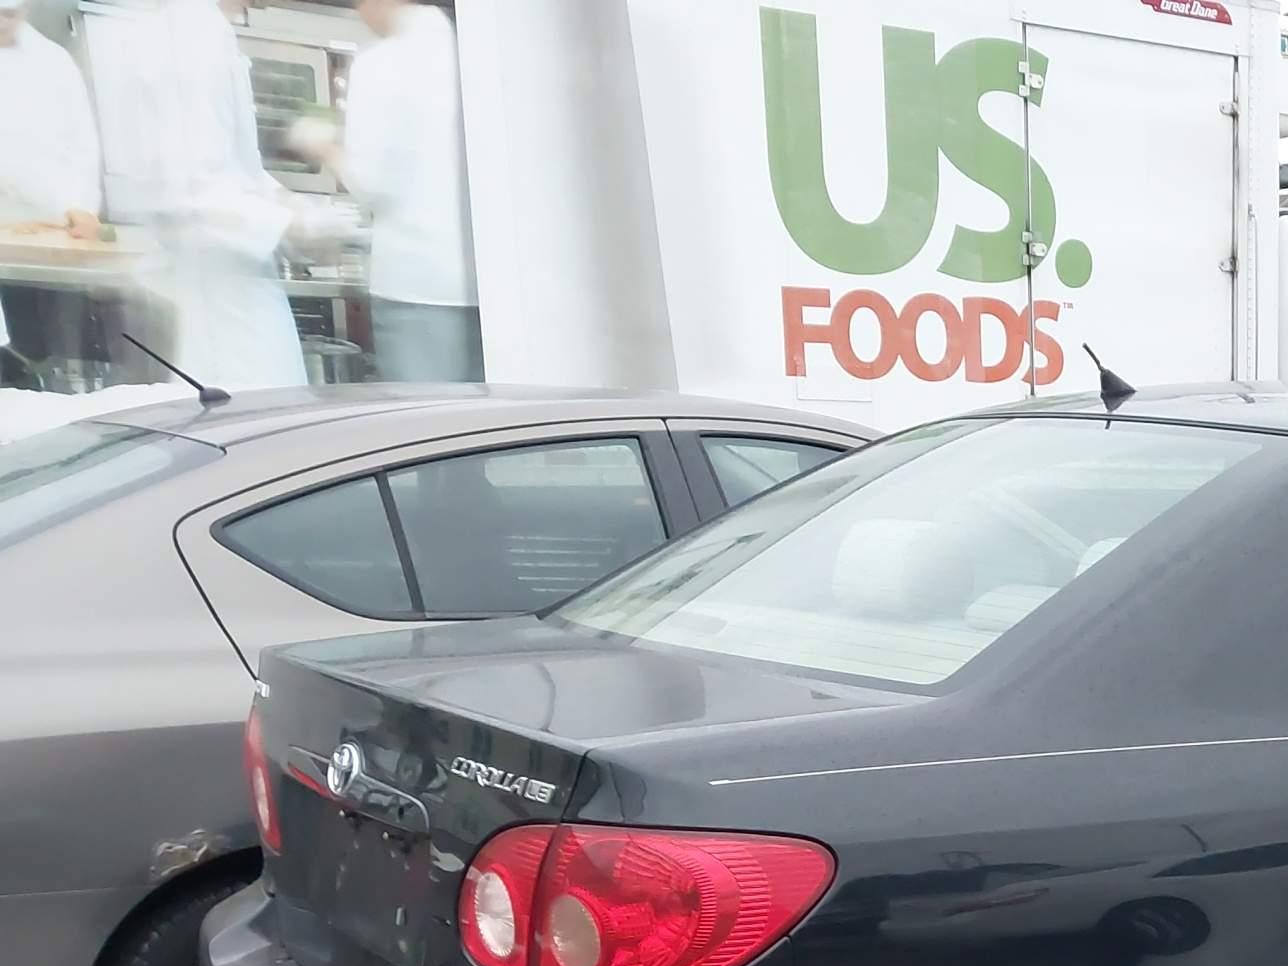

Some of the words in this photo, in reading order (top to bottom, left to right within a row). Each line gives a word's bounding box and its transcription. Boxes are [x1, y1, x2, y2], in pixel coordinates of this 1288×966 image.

[1190, 0, 1218, 19] Dane
[781, 286, 1064, 386] FOODS
[450, 756, 529, 797] COROLLA
[523, 778, 556, 804] LE
